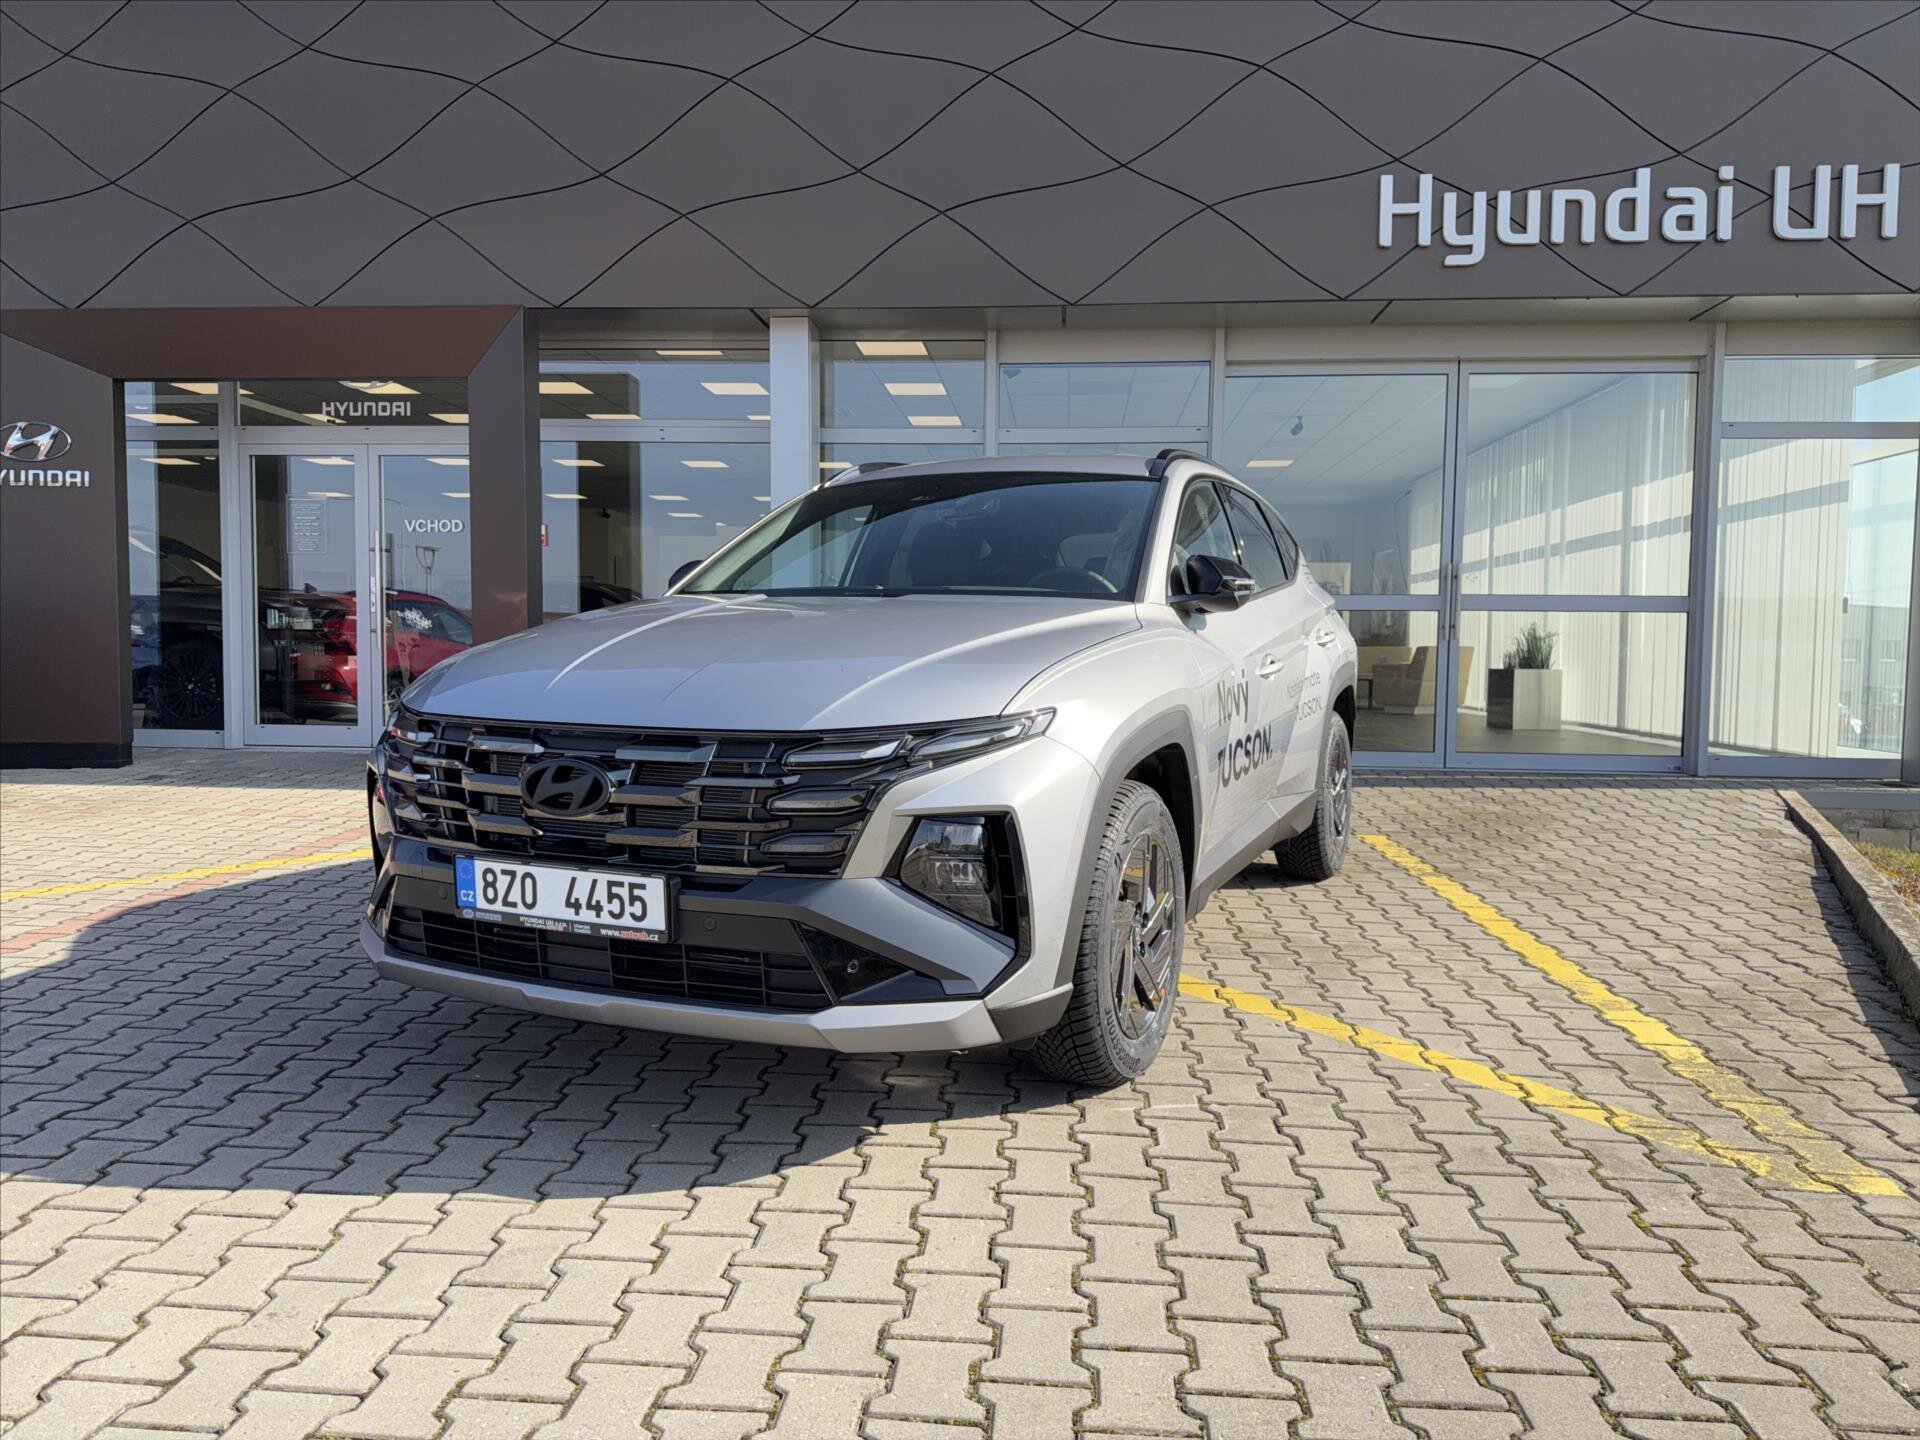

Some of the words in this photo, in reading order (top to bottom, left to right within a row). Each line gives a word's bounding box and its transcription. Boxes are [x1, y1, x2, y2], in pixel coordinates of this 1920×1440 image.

[1378, 165, 1735, 267] Hyundai
[1772, 162, 1901, 242] UH
[321, 401, 412, 417] HYUNDAI
[404, 518, 465, 533] VCHOD
[1216, 668, 1249, 727] Nový
[1216, 723, 1273, 793] TUCSON.
[460, 889, 475, 902] CZ
[565, 876, 648, 923] 4455
